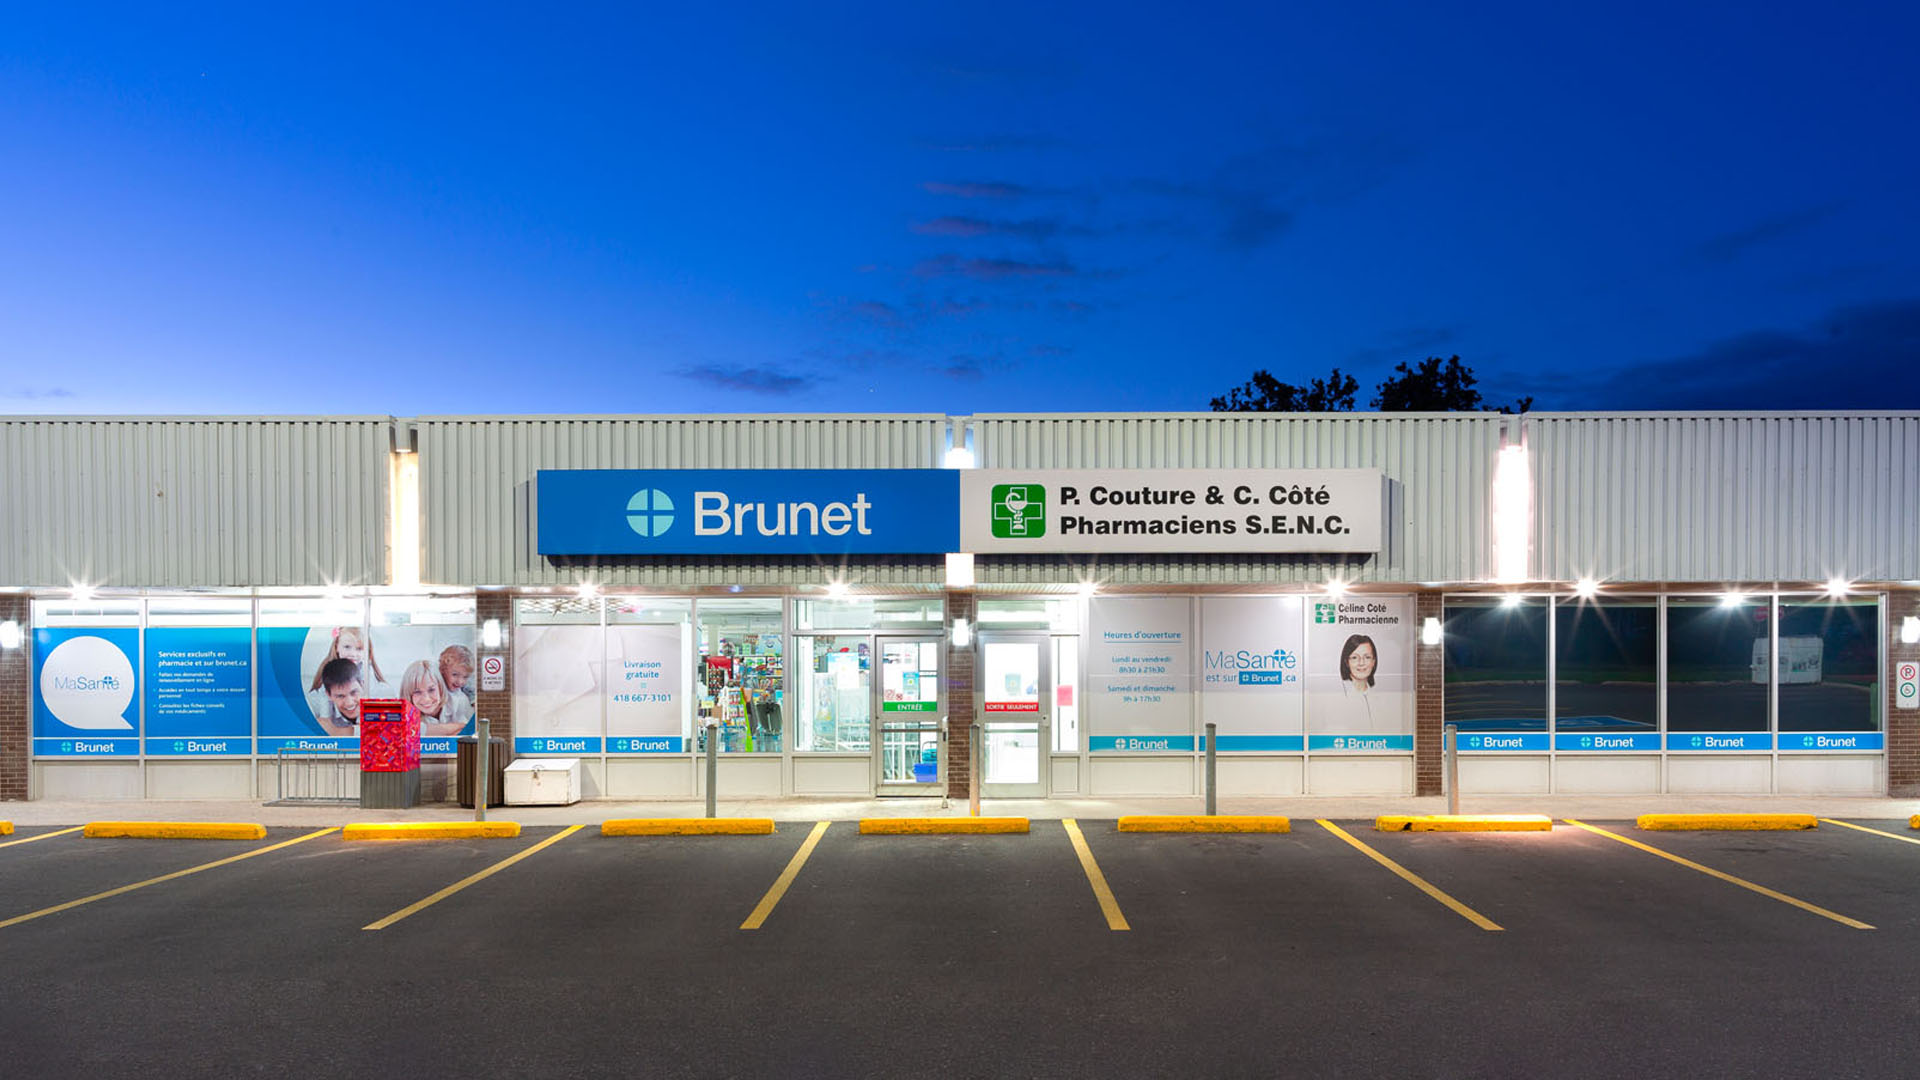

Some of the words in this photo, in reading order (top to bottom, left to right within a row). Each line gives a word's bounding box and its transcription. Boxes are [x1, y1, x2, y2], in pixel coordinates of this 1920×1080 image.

[1060, 487, 1080, 505] P.
[1090, 486, 1195, 505] Couture
[1205, 486, 1225, 505] &
[1233, 486, 1259, 505] C.
[1269, 485, 1330, 505] Côté
[694, 491, 872, 536] Brunet
[1060, 515, 1237, 535] Pharmaciens
[1246, 515, 1350, 535] S.E.N.C.
[1338, 615, 1399, 624] Pharmacienne
[1134, 630, 1181, 639] d'ouverture
[158, 650, 185, 658] Services
[187, 650, 216, 658] exclusifs
[1205, 650, 1296, 669] MaSanté
[158, 660, 193, 668] pharmacie
[624, 660, 661, 668] Livraison
[626, 671, 659, 680] gratuite
[1206, 674, 1220, 682] est
[1251, 674, 1280, 682] Brunet
[54, 675, 120, 690] MaSanté
[613, 694, 630, 702] 418
[631, 694, 672, 702] 667-3101
[75, 741, 114, 752] Brunet
[187, 741, 227, 752] Brunet
[420, 741, 449, 751] runet
[547, 740, 586, 751] Brunet
[631, 740, 670, 750] Brunet
[1129, 738, 1168, 749] Brunet
[1348, 738, 1387, 749] Brunet
[1484, 737, 1523, 748] Brunet
[1595, 737, 1634, 748] Brunet
[1705, 737, 1744, 748] Brunet
[1817, 736, 1856, 747] Brunet
